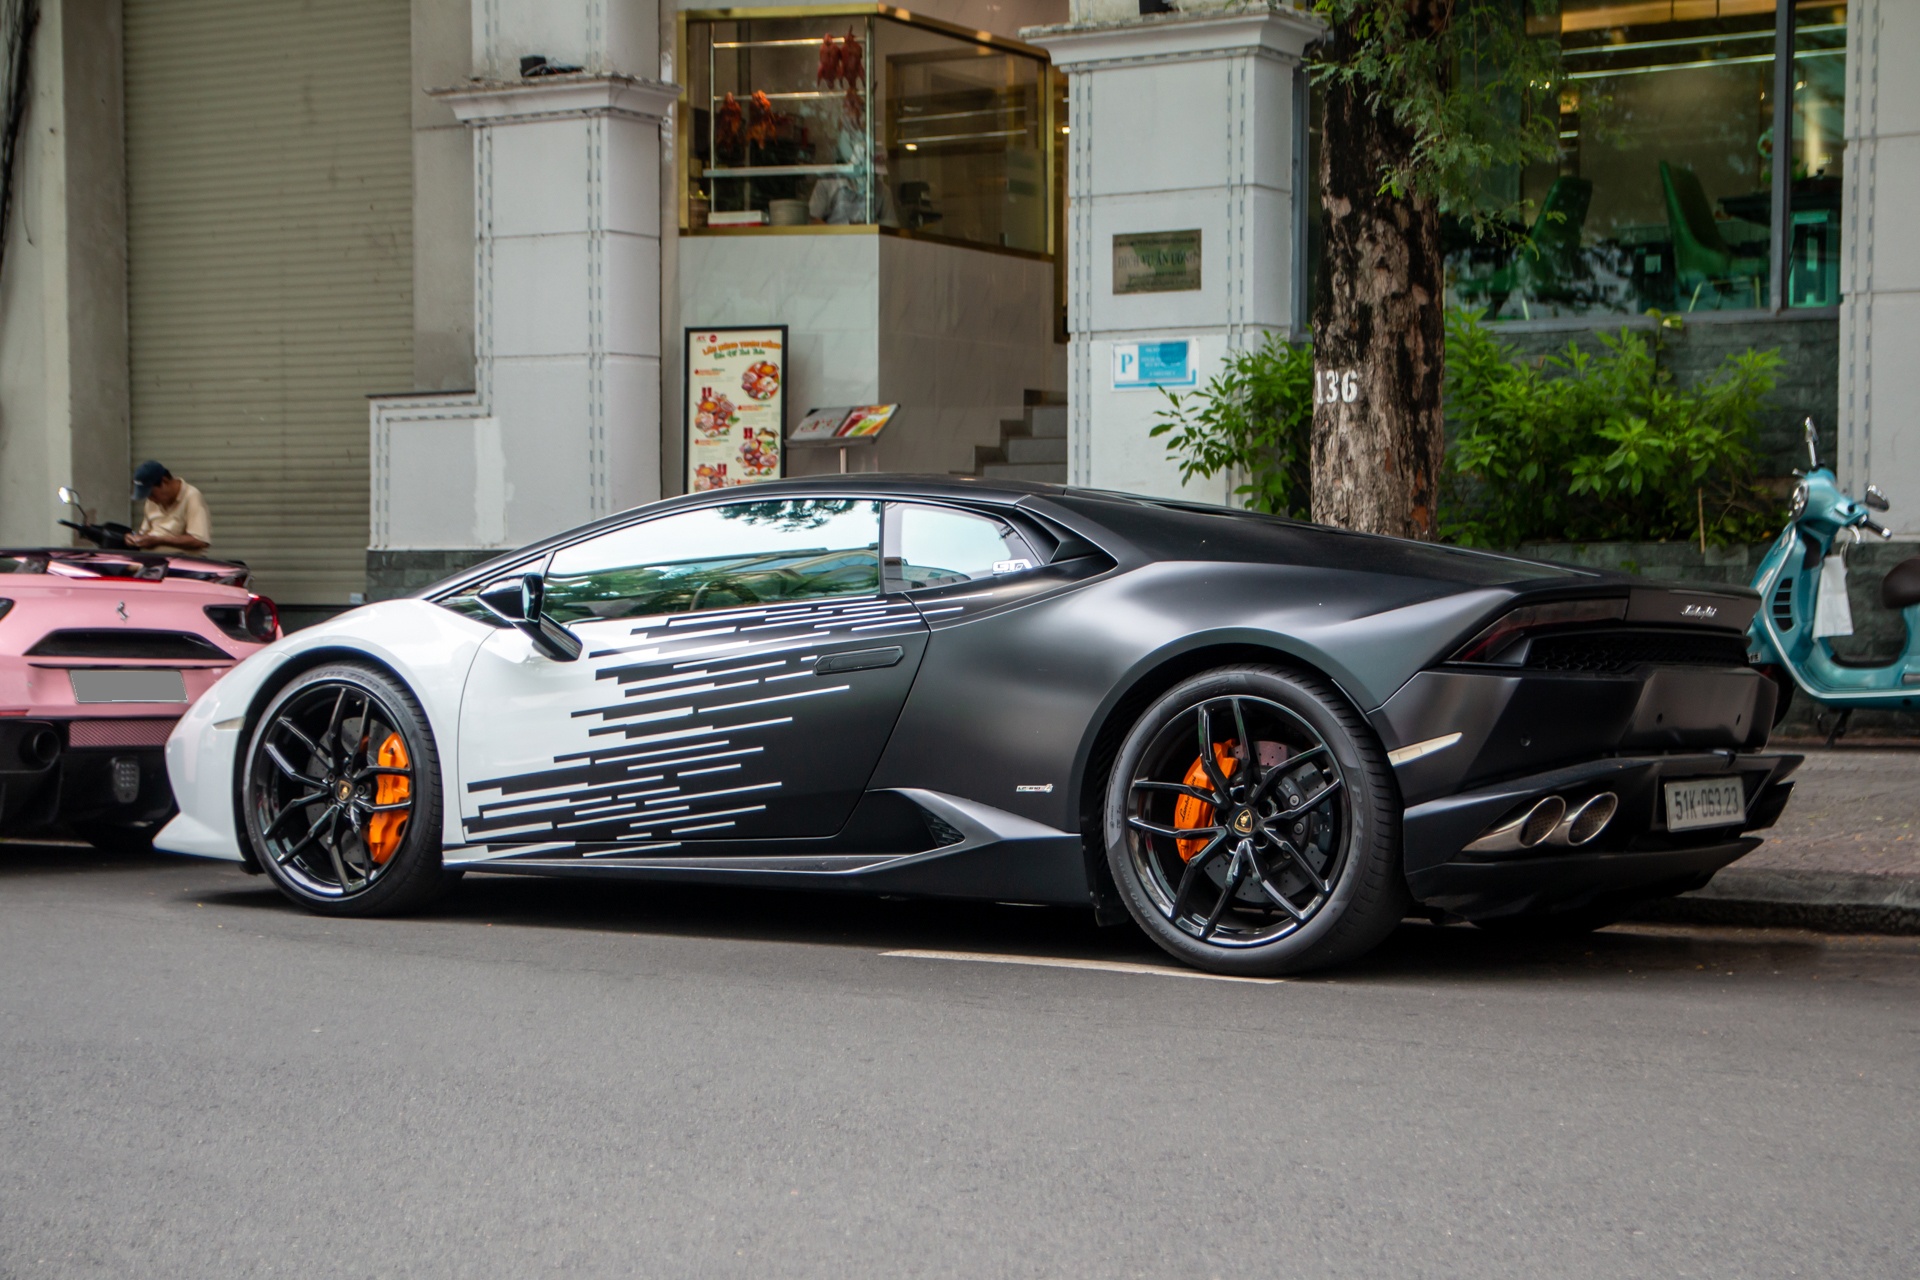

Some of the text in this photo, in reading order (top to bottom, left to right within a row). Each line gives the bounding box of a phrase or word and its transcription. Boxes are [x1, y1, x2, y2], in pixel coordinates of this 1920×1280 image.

[1121, 353, 1133, 374] P
[1317, 369, 1357, 405] 136
[1180, 775, 1197, 823] Lamboini
